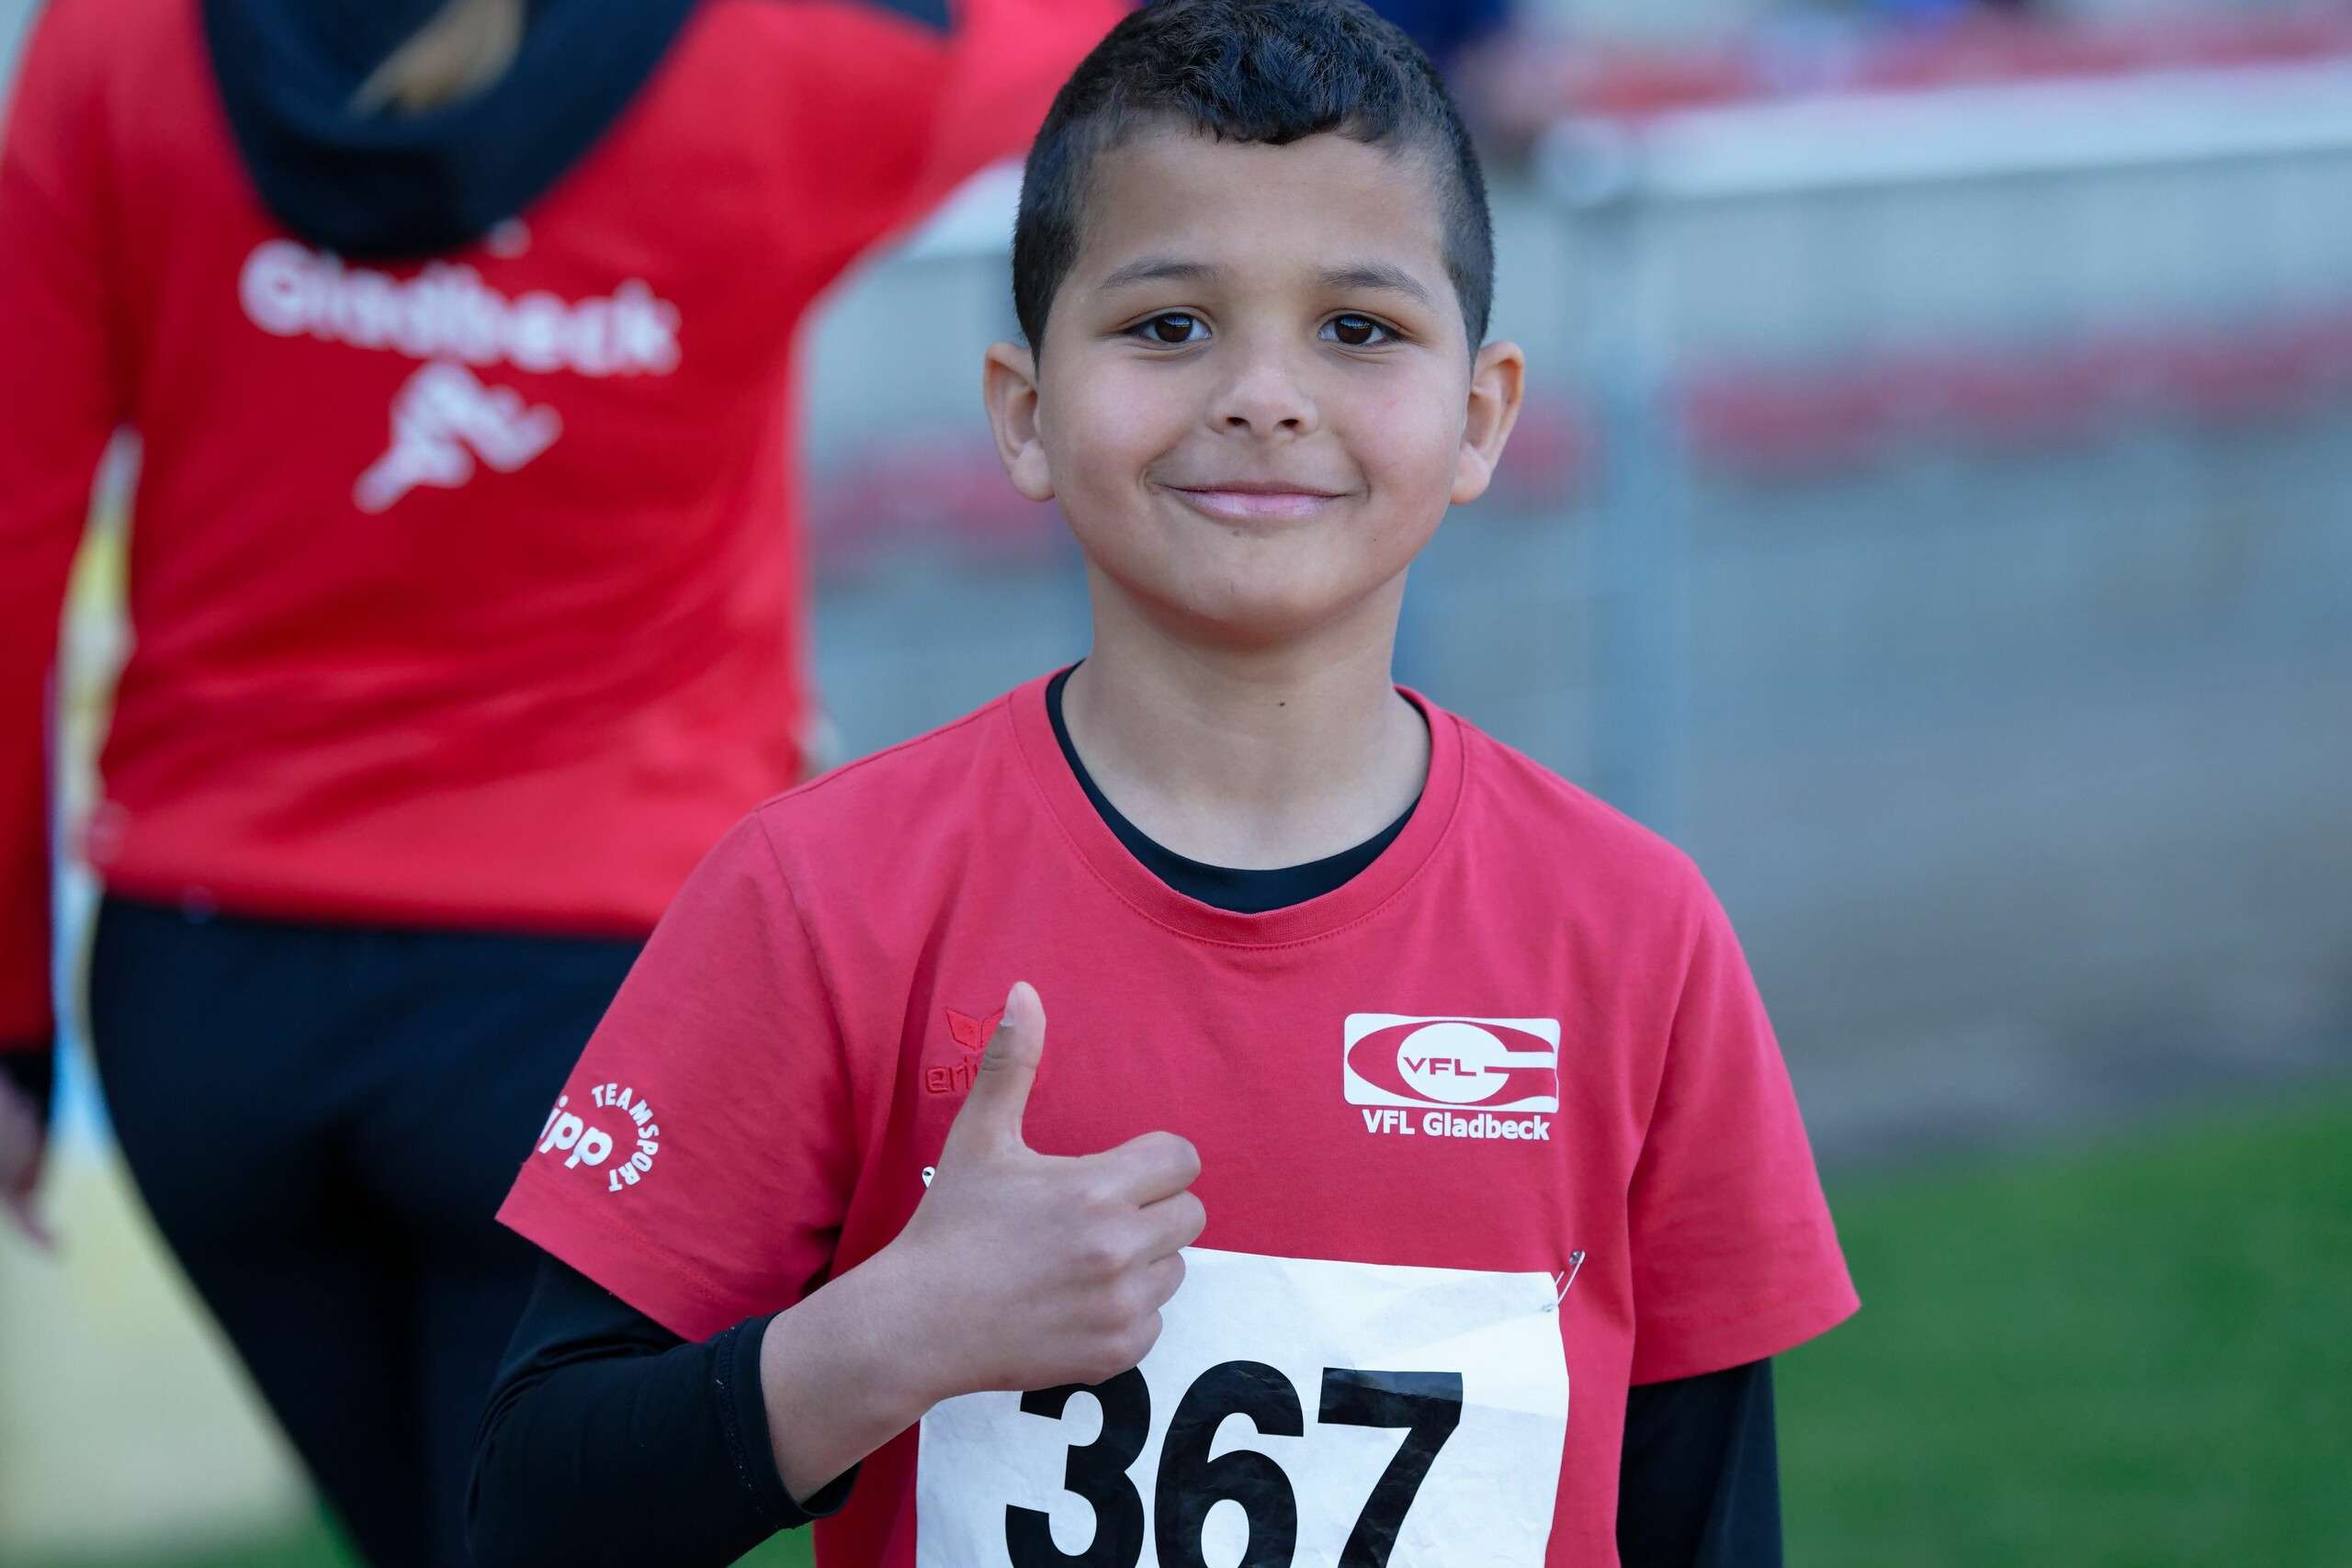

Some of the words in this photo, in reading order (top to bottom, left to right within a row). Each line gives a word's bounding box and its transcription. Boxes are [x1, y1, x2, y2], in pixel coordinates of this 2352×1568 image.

[1403, 1056, 1476, 1077] VFL
[591, 1082, 660, 1192] TEAMSPORT
[1362, 1109, 1415, 1134] VFL
[1422, 1112, 1551, 1141] Gladbeck
[1005, 1359, 1464, 1568] 367
